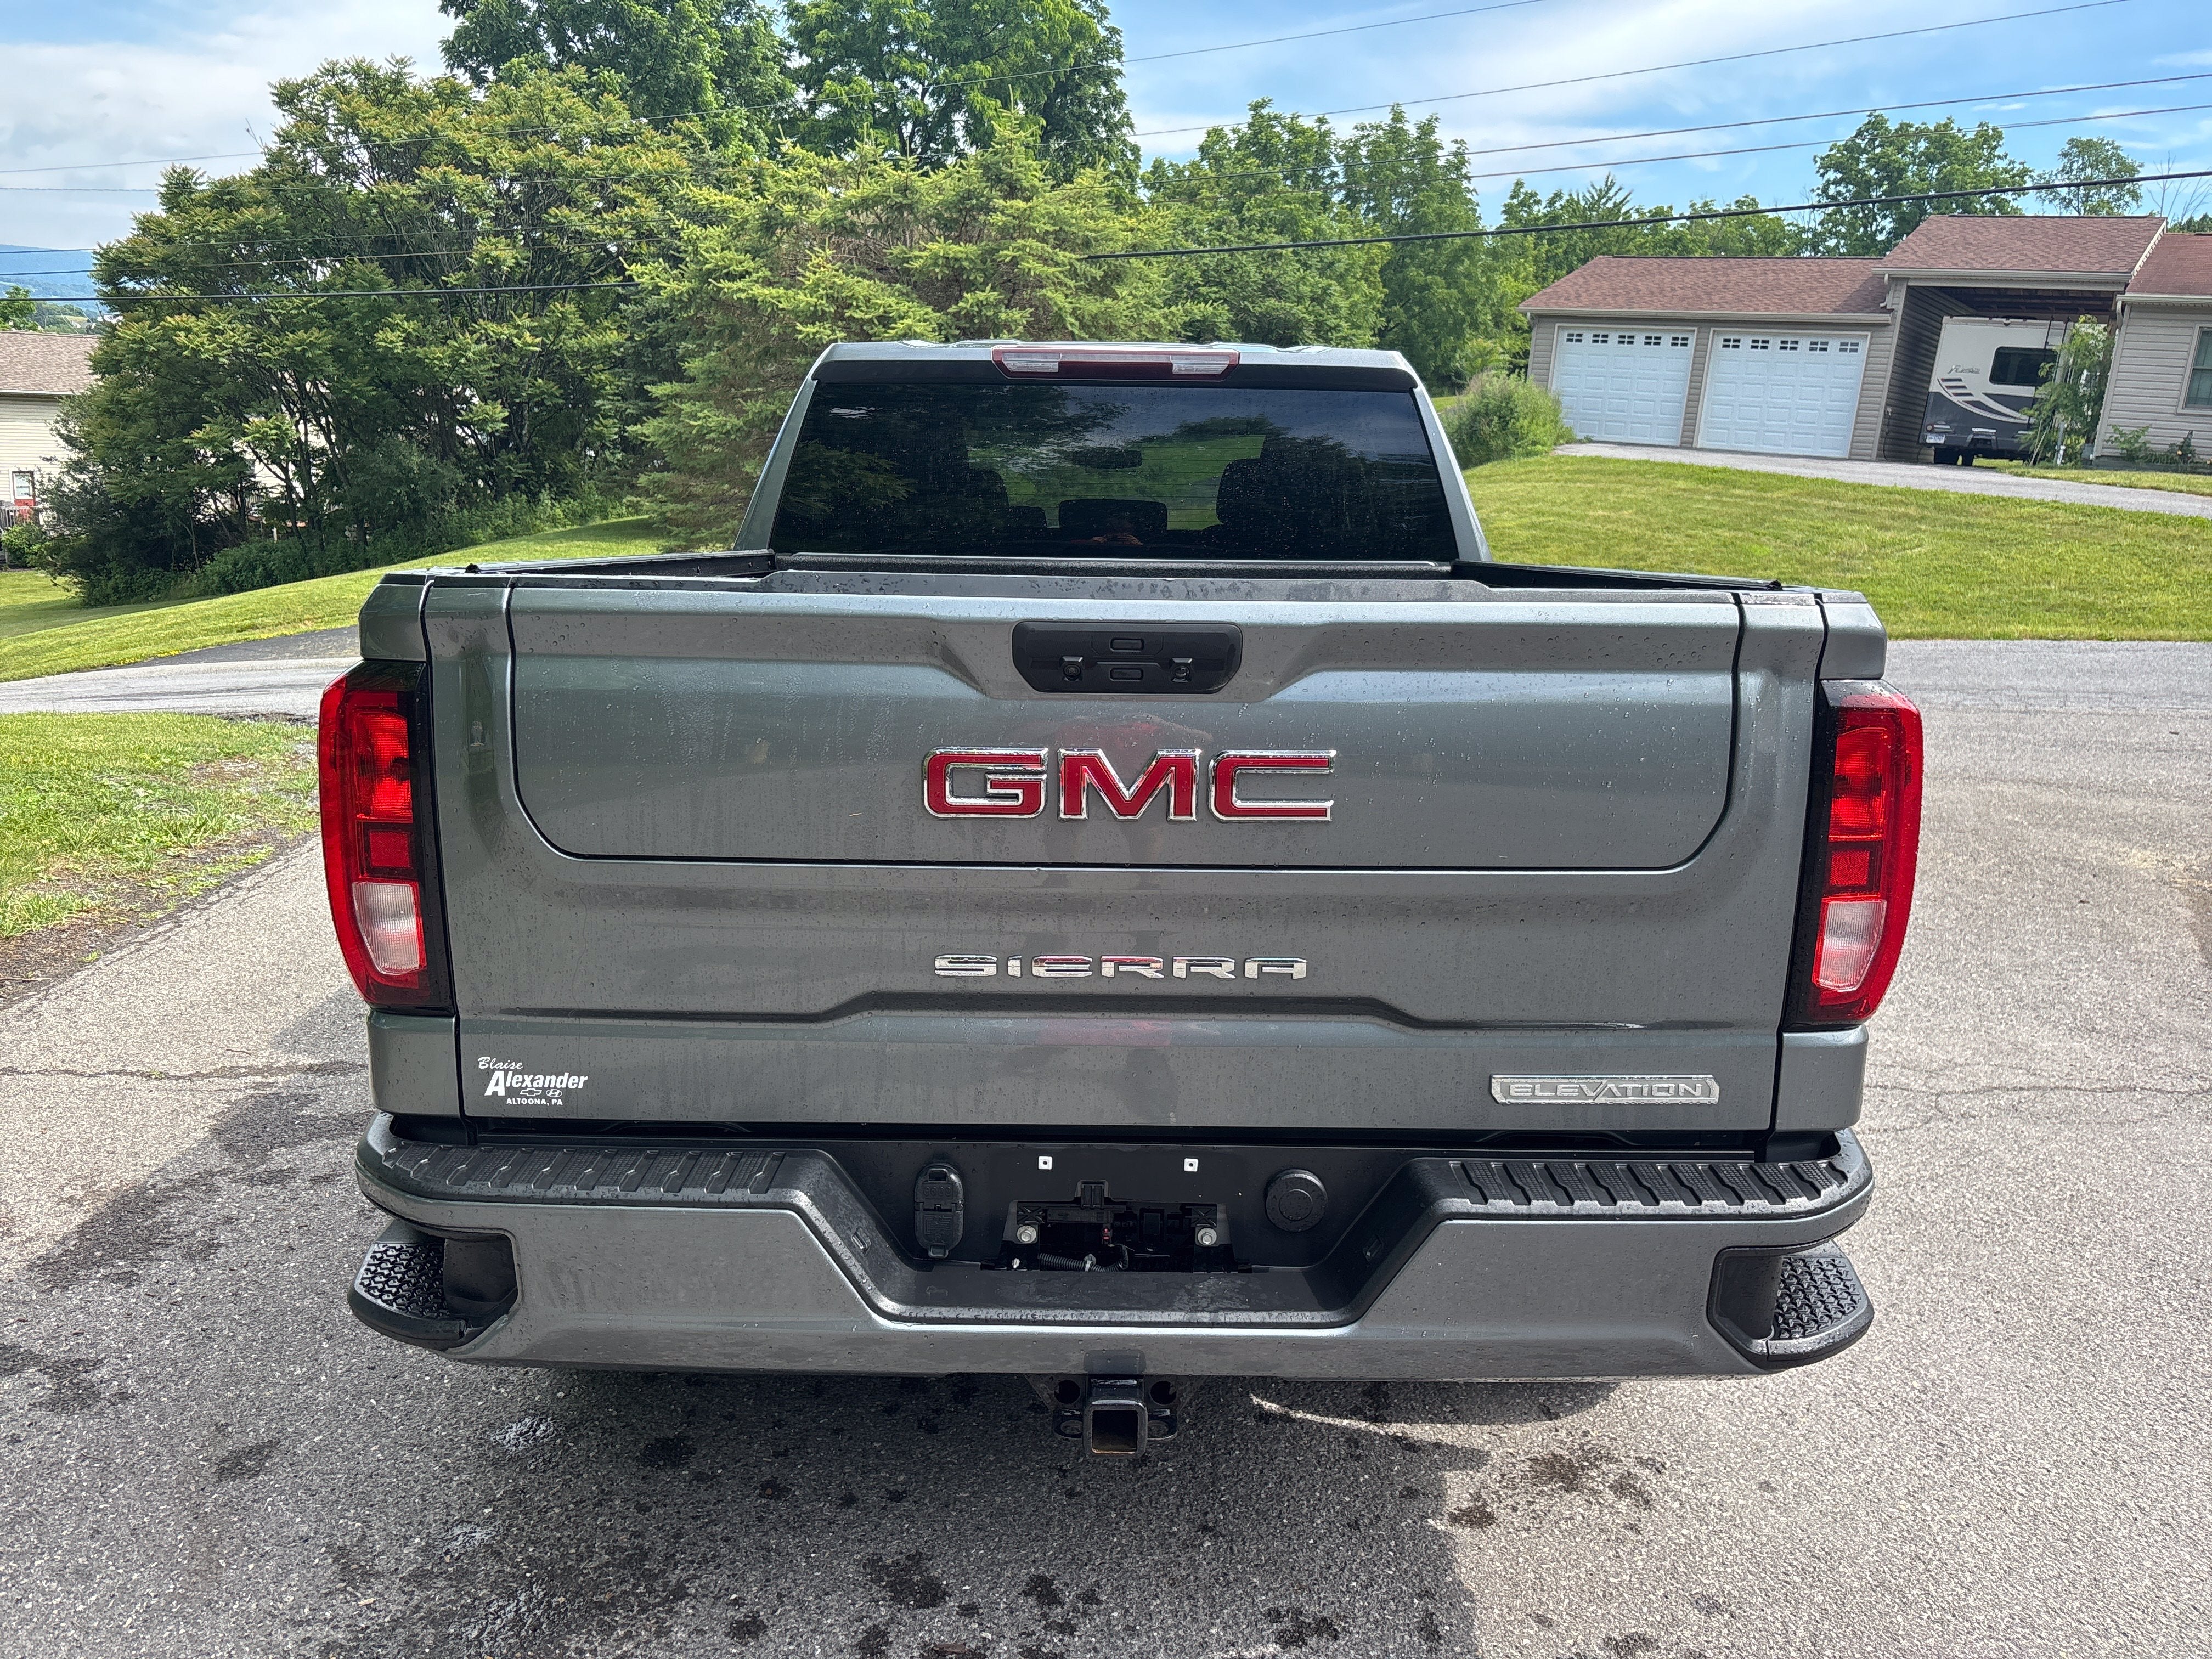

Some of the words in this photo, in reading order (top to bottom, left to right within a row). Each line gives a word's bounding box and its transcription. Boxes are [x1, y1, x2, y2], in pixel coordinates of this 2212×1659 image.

[923, 747, 1337, 821] GMC
[934, 954, 1308, 980] SIERRA
[477, 1056, 523, 1070] Blaise
[484, 1070, 589, 1096] Alexander
[1509, 1084, 1702, 1097] ELEVATION
[506, 1097, 550, 1106] ALTOONA,
